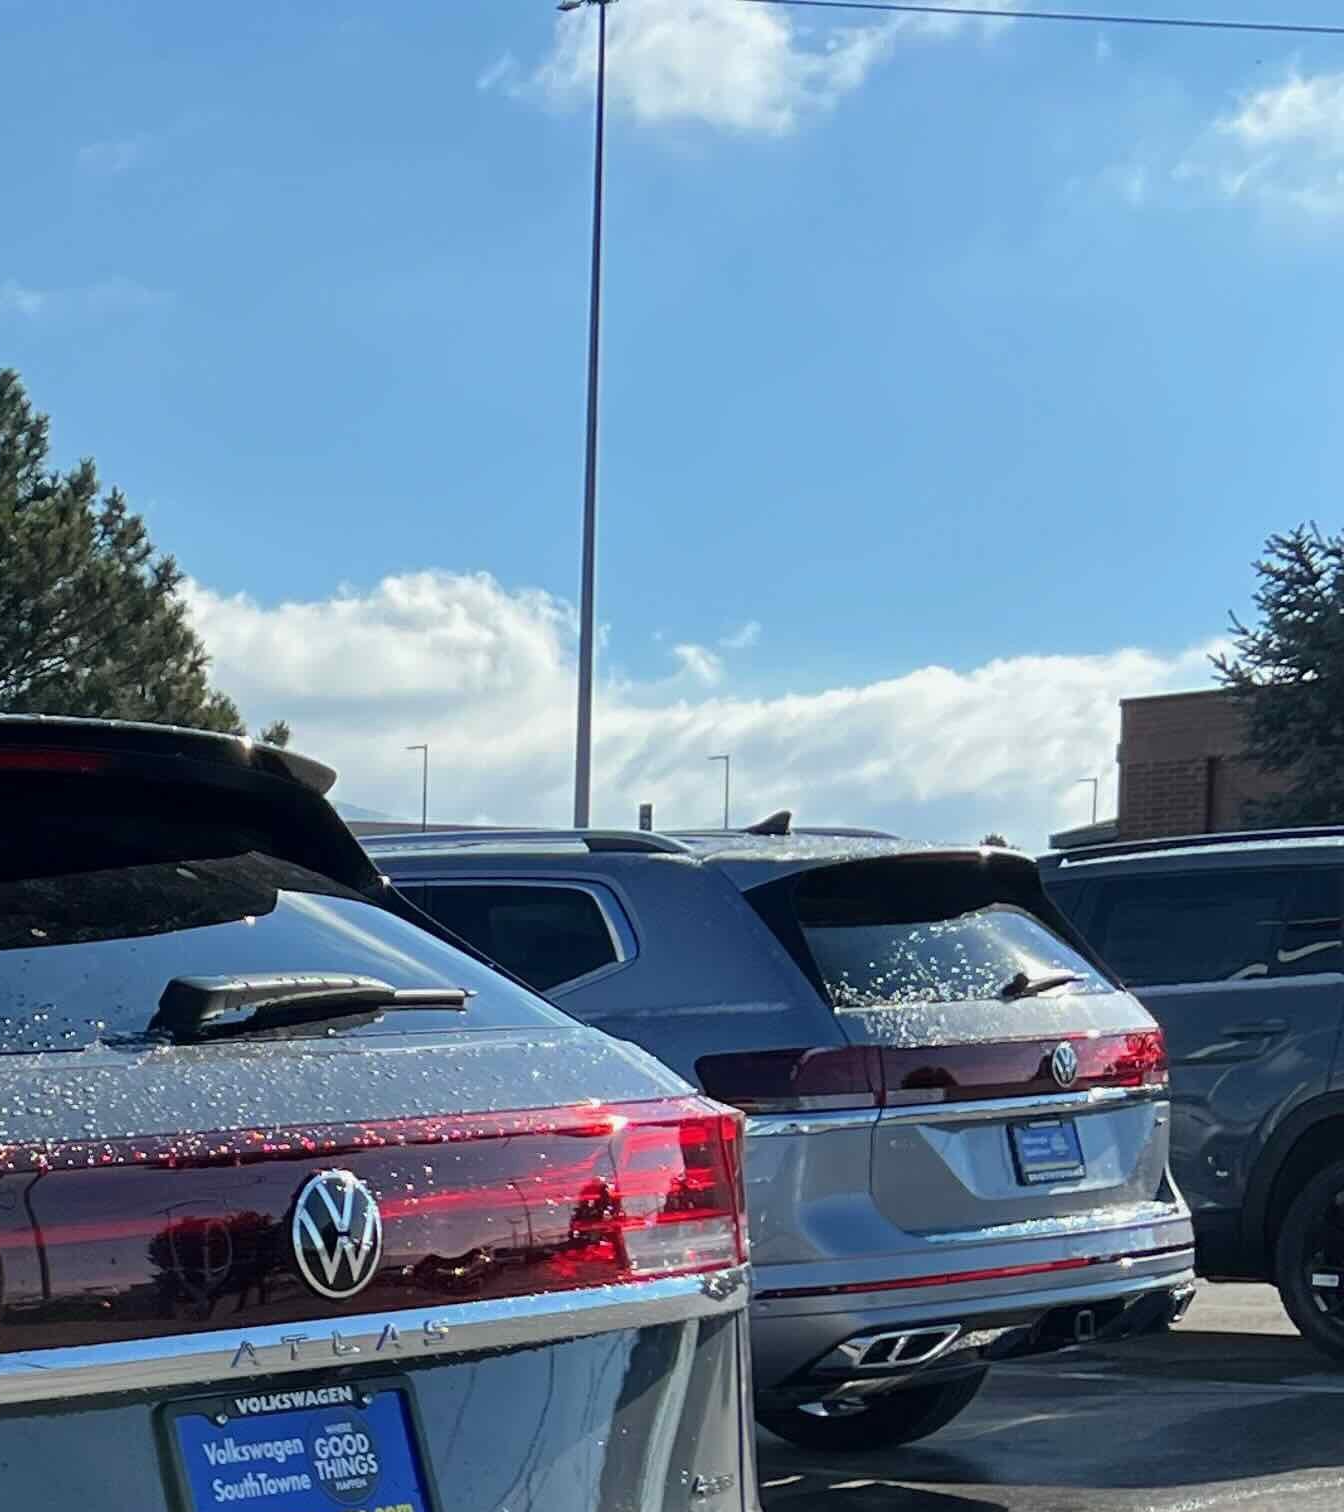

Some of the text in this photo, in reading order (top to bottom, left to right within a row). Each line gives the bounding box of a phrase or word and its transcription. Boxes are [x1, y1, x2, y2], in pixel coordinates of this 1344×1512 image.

[231, 1320, 449, 1368] ATLAS
[236, 1386, 353, 1414] VOLKSWAGEN
[202, 1437, 304, 1466] Volkswagen
[315, 1433, 369, 1459] GOOD
[314, 1453, 378, 1480] THINGS
[213, 1471, 311, 1502] SouthTowne
